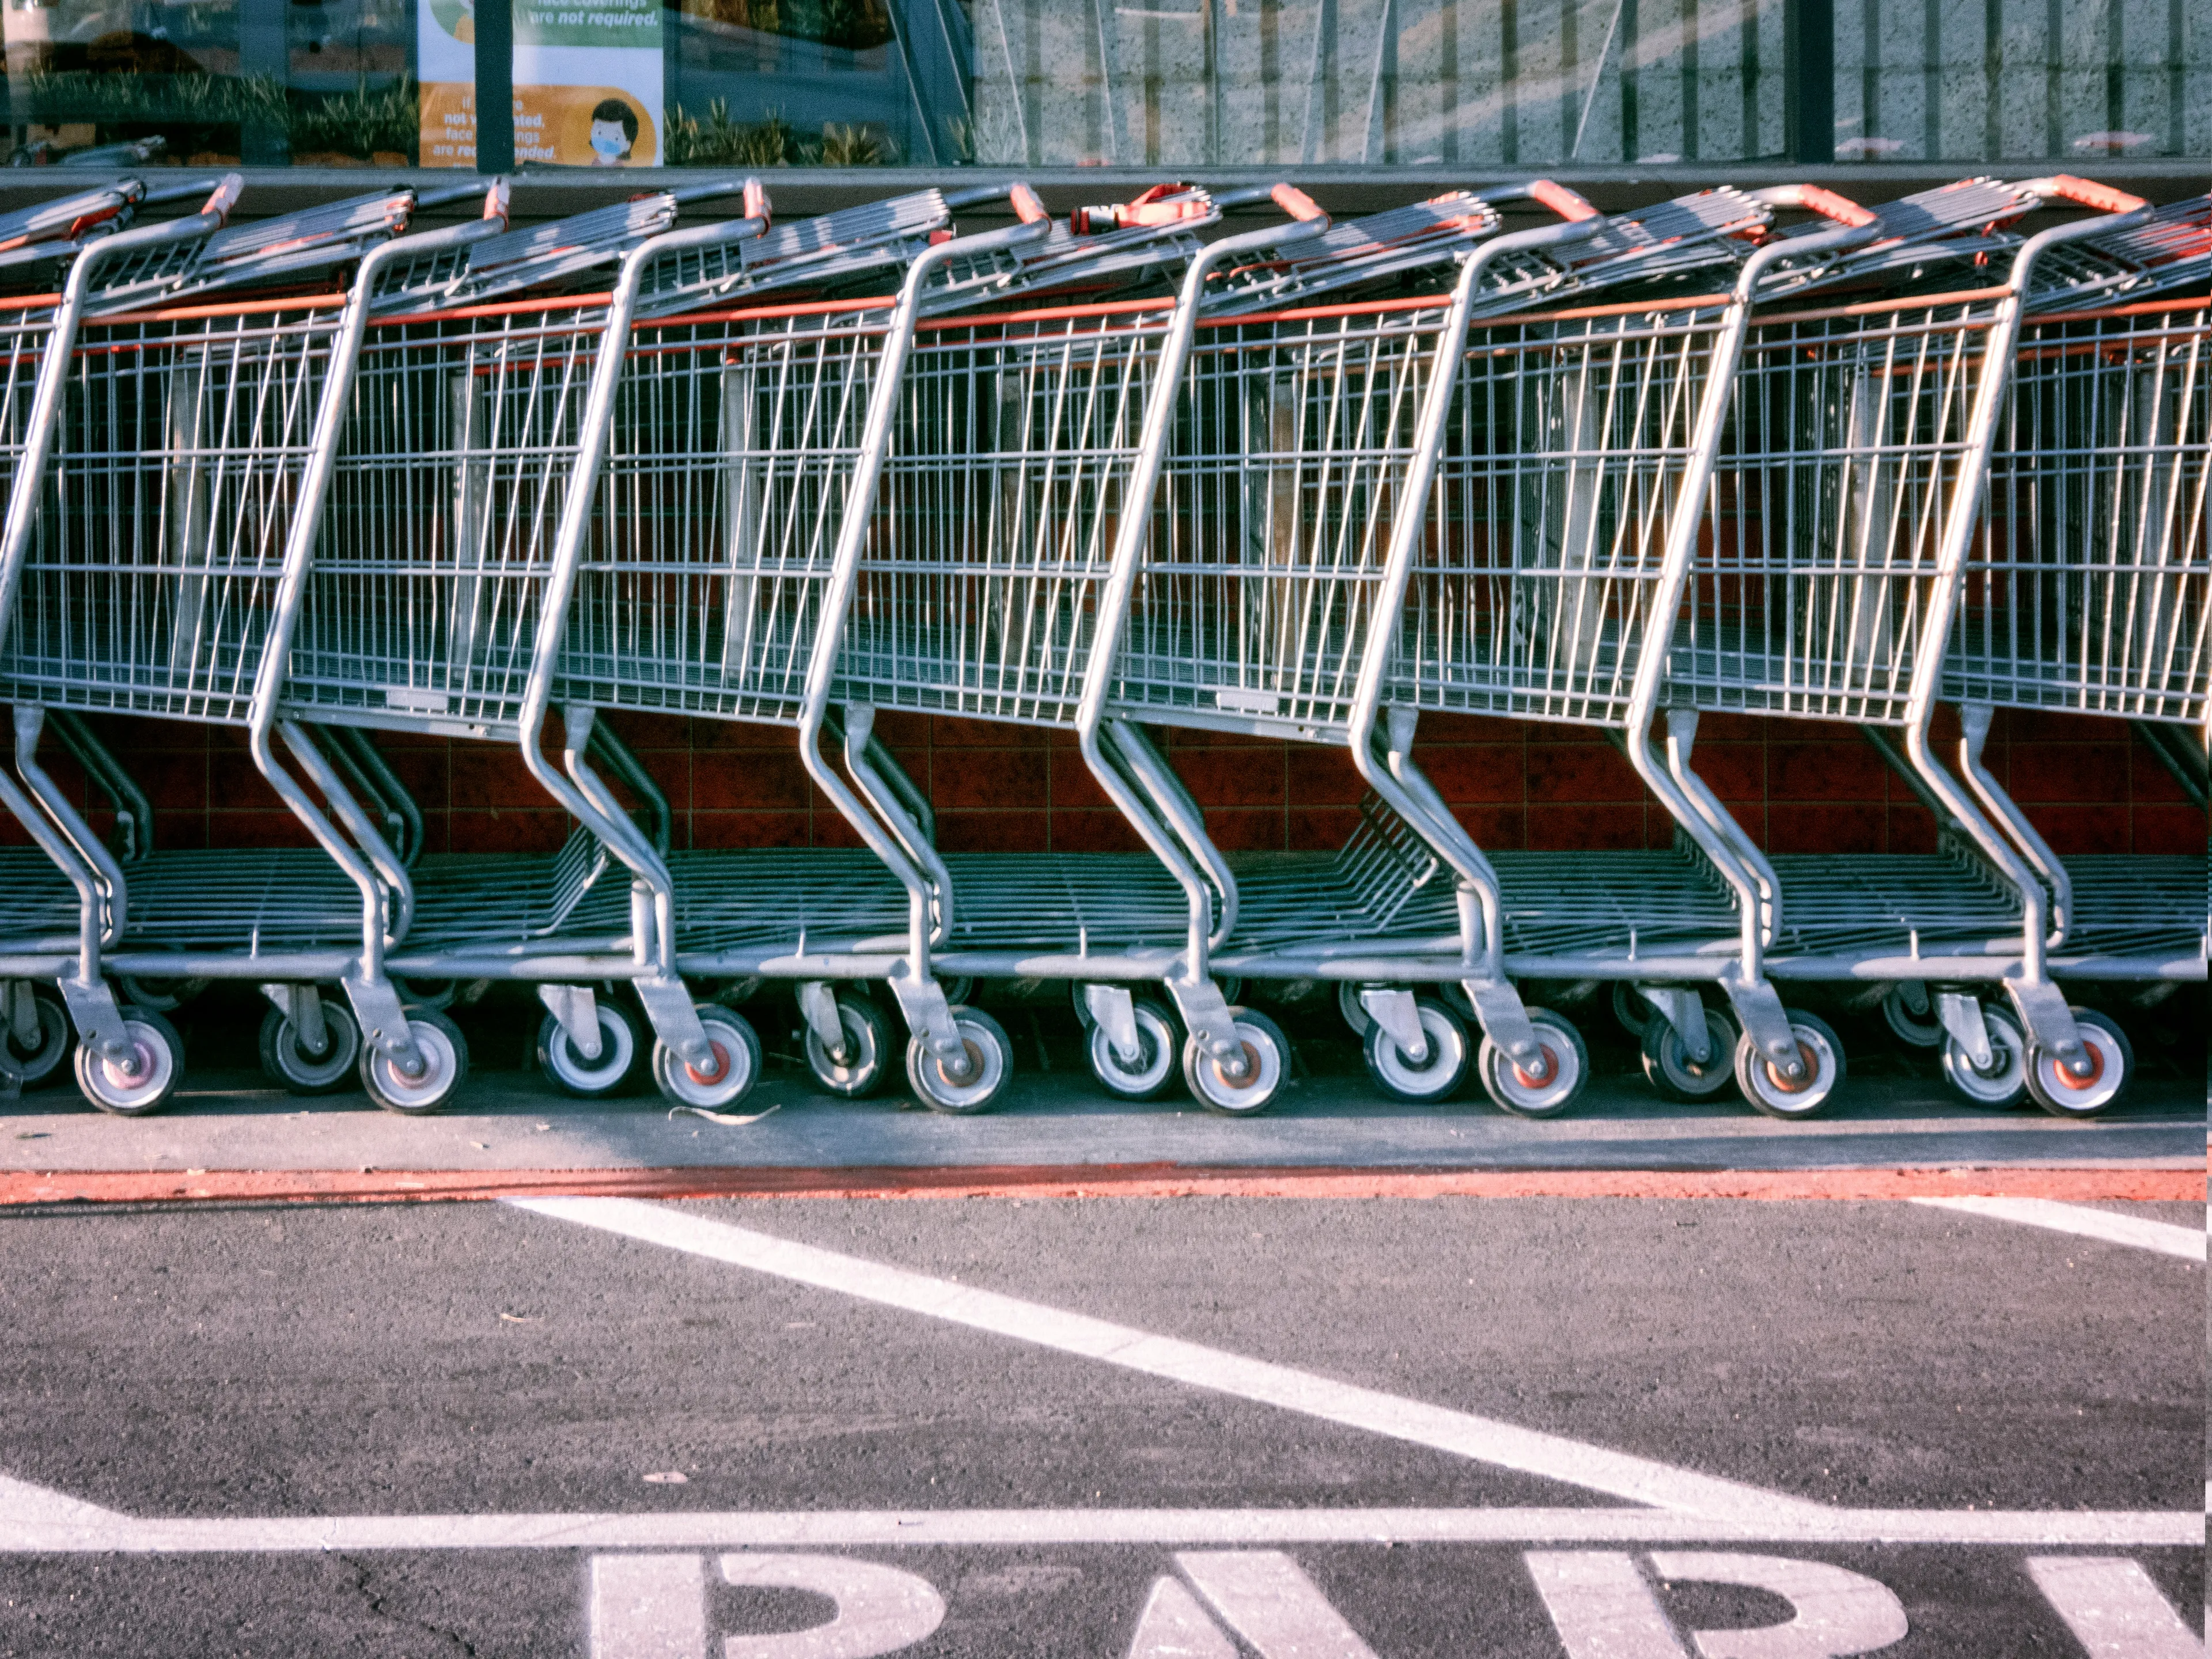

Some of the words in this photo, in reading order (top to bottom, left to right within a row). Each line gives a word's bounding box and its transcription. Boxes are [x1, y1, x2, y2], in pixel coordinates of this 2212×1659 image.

[558, 10, 584, 25] not
[587, 10, 658, 28] required.
[444, 113, 466, 125] not
[446, 127, 472, 141] face
[433, 145, 453, 156] are
